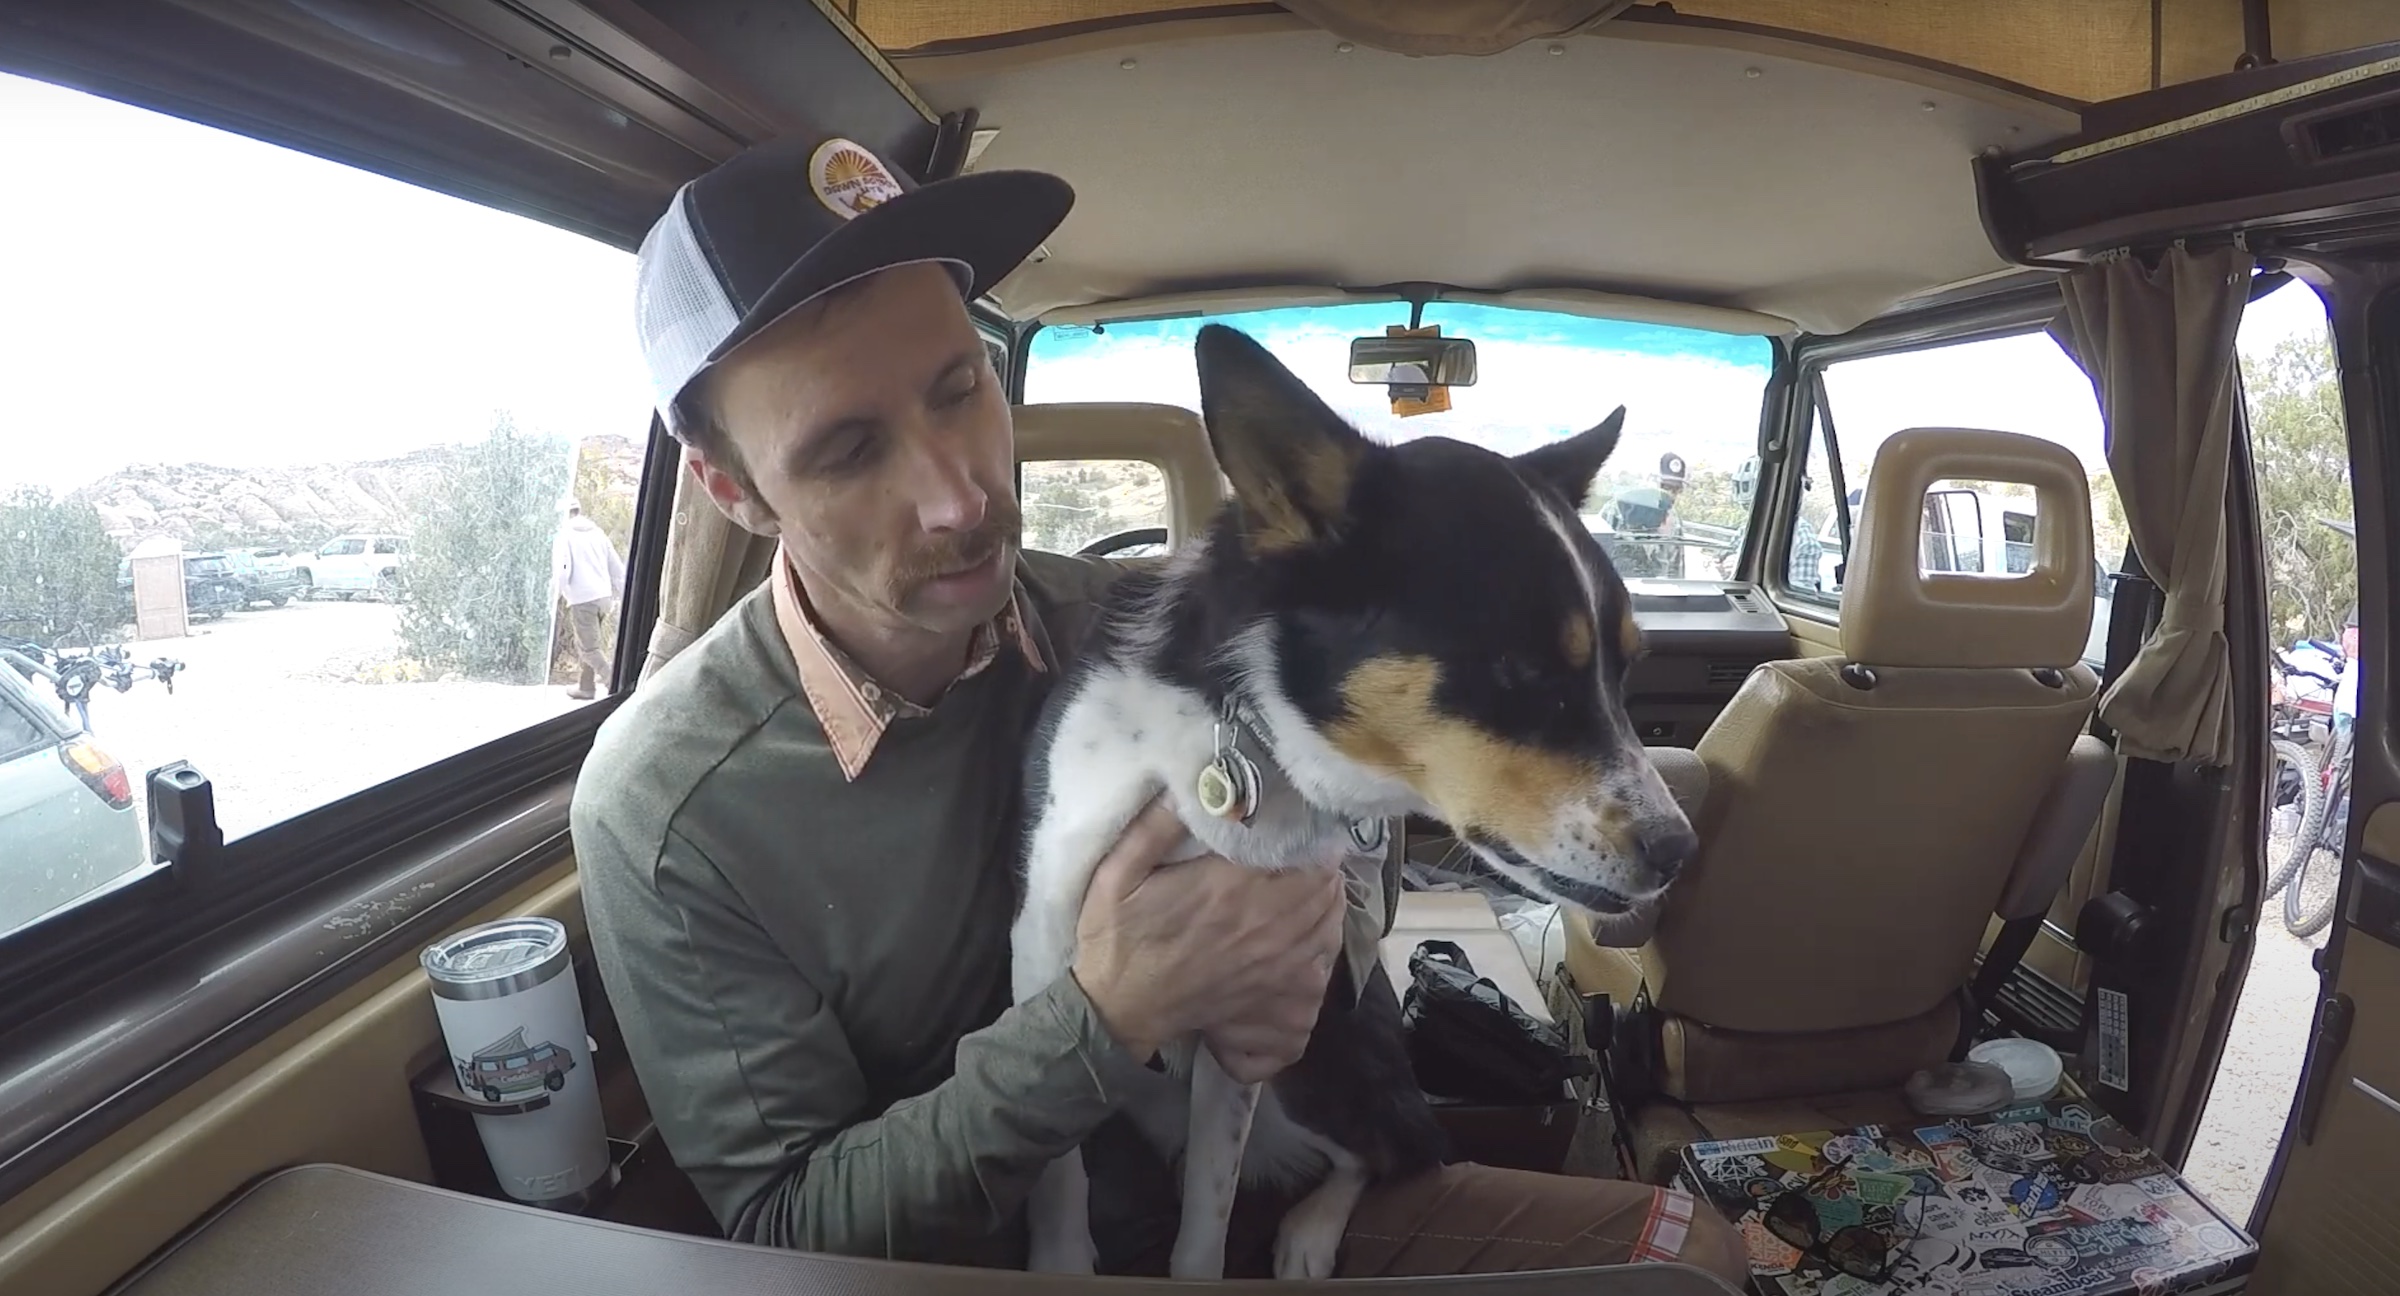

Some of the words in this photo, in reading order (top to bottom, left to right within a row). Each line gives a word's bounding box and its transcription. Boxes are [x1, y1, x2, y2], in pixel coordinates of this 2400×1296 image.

[1994, 1105, 2042, 1119] YETI
[513, 1166, 580, 1197] YETI
[2103, 1164, 2163, 1182] Colorado
[2019, 1184, 2043, 1217] Park
[2066, 1219, 2122, 1244] BRIDGES
[1751, 1262, 1785, 1270] KENDA
[2010, 1269, 2107, 1296] Steamboat
